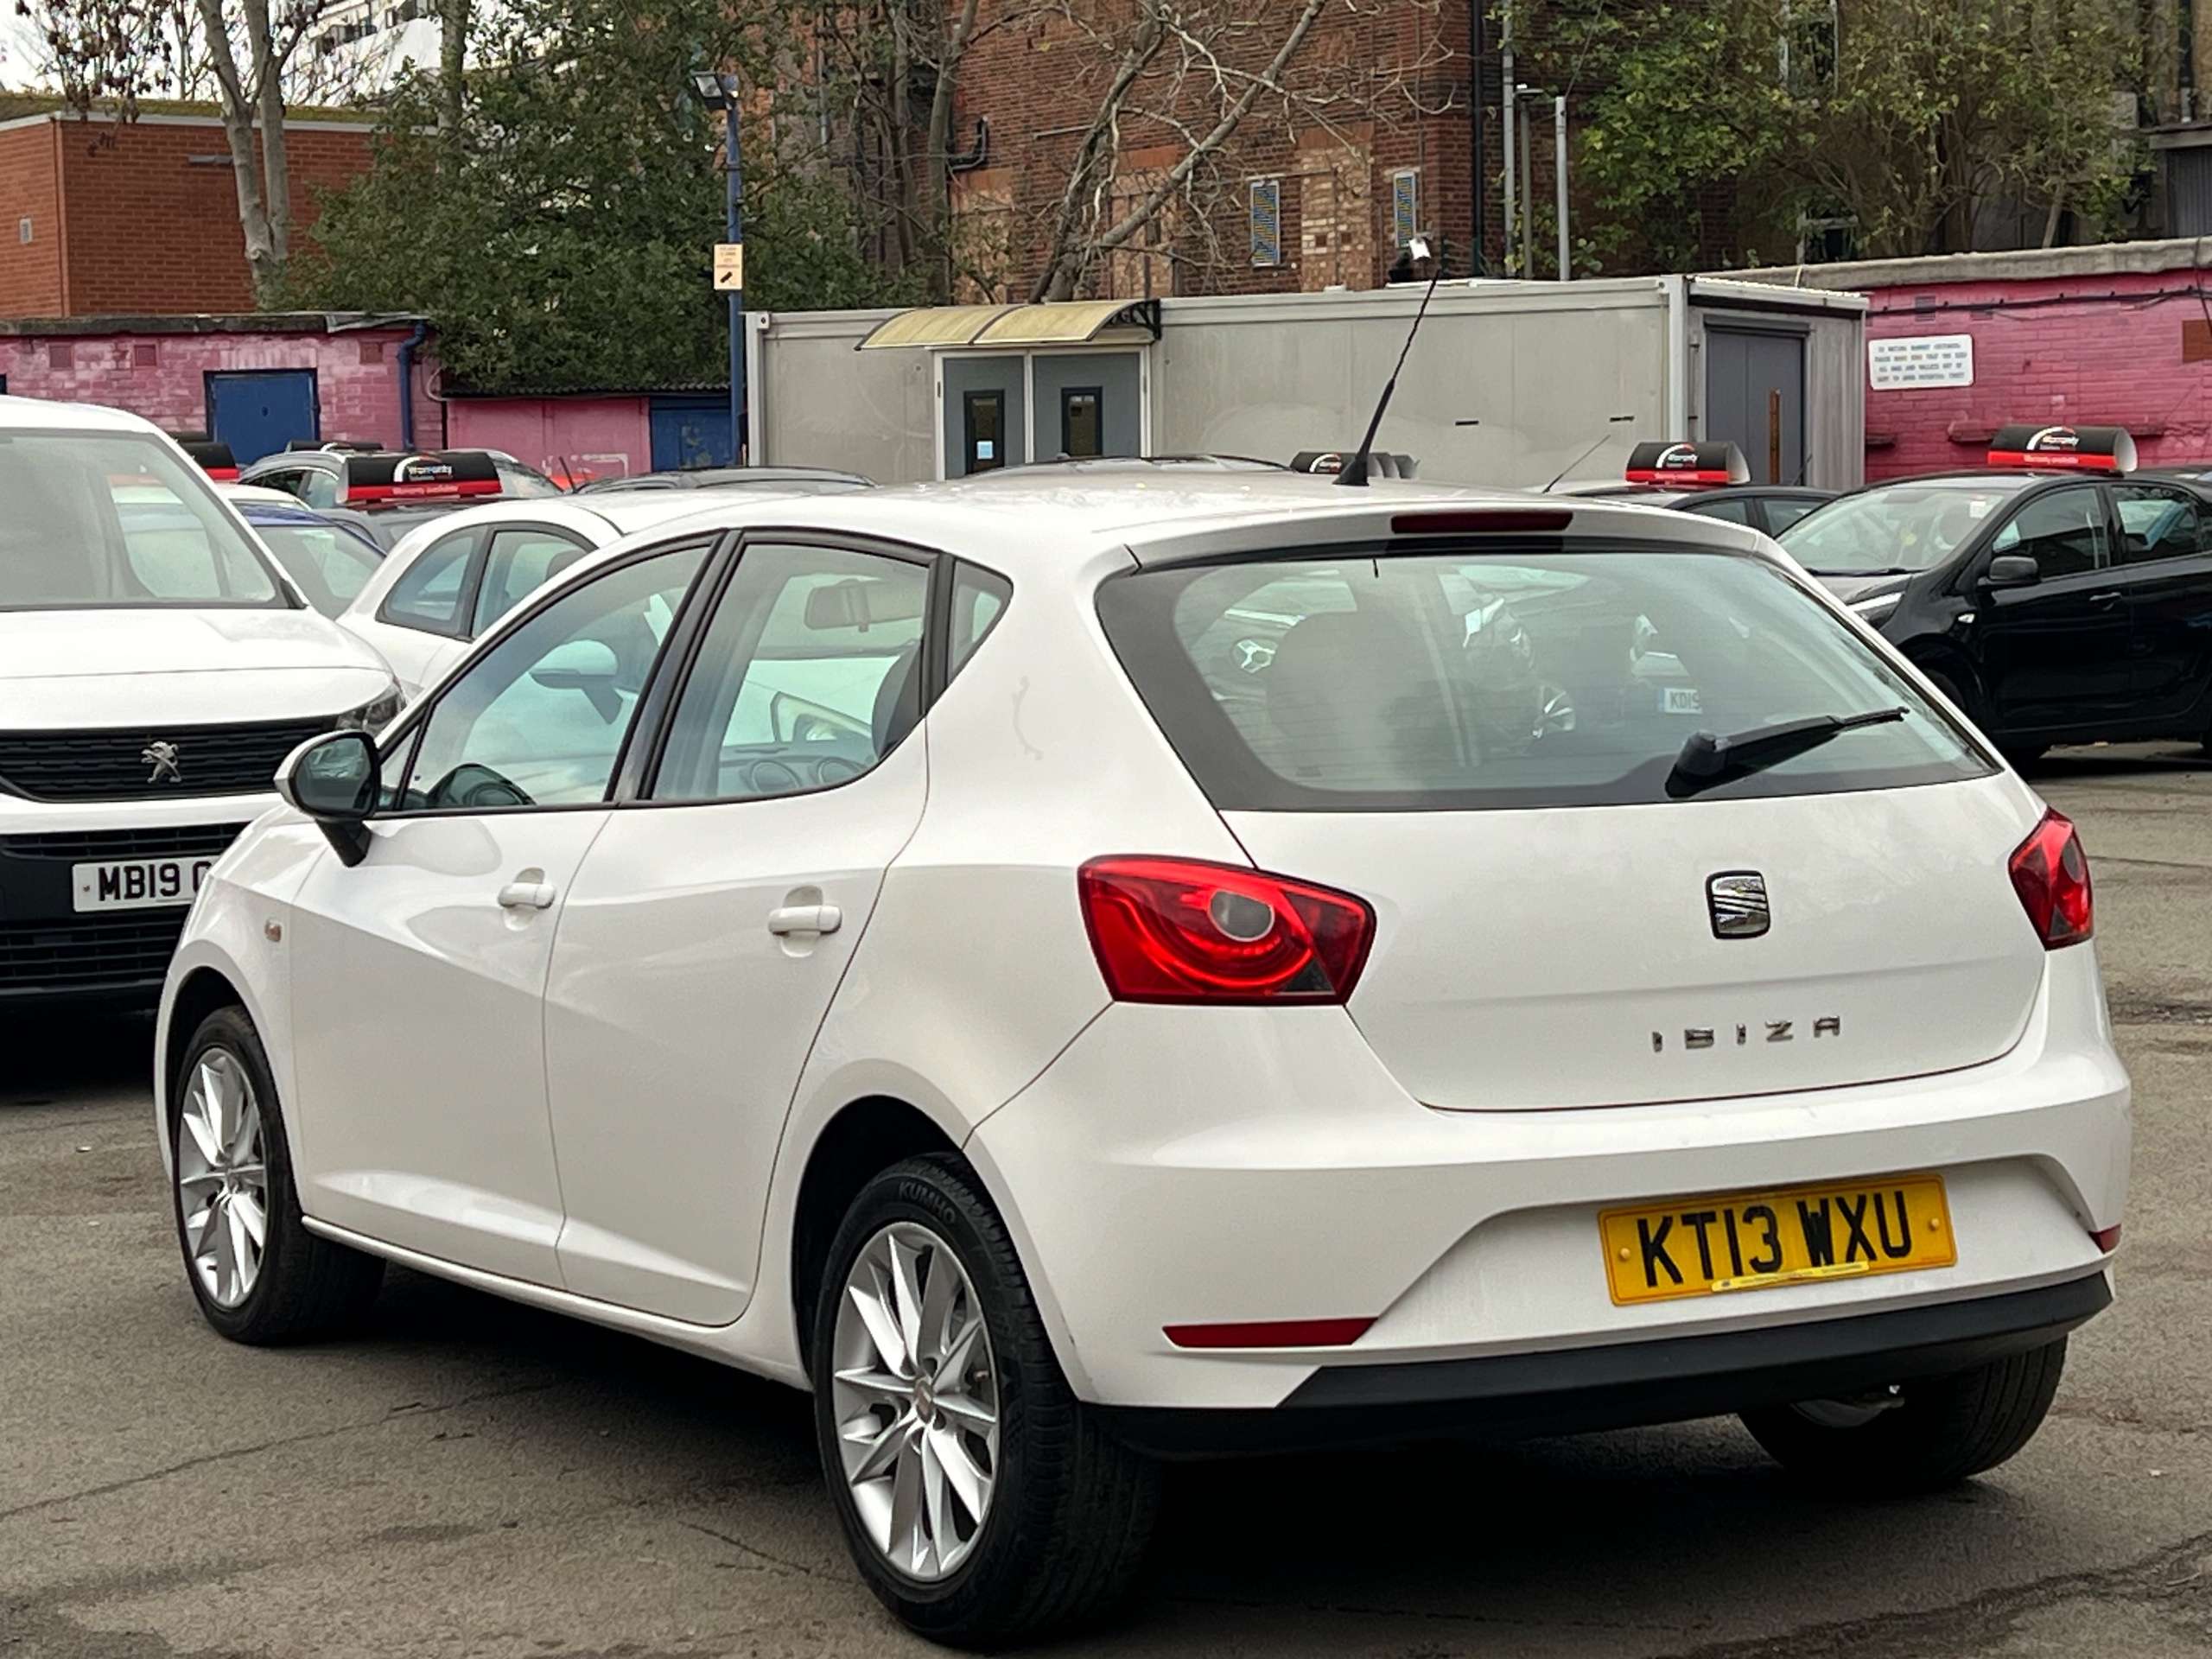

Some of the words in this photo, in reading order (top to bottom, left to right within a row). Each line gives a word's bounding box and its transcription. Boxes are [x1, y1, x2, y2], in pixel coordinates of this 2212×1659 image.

[99, 862, 180, 901] MB19
[1652, 1015, 1841, 1052] IBIZA
[899, 1181, 957, 1224] KUMHO
[1637, 1205, 1783, 1287] KT13
[1797, 1190, 1913, 1268] WXU
